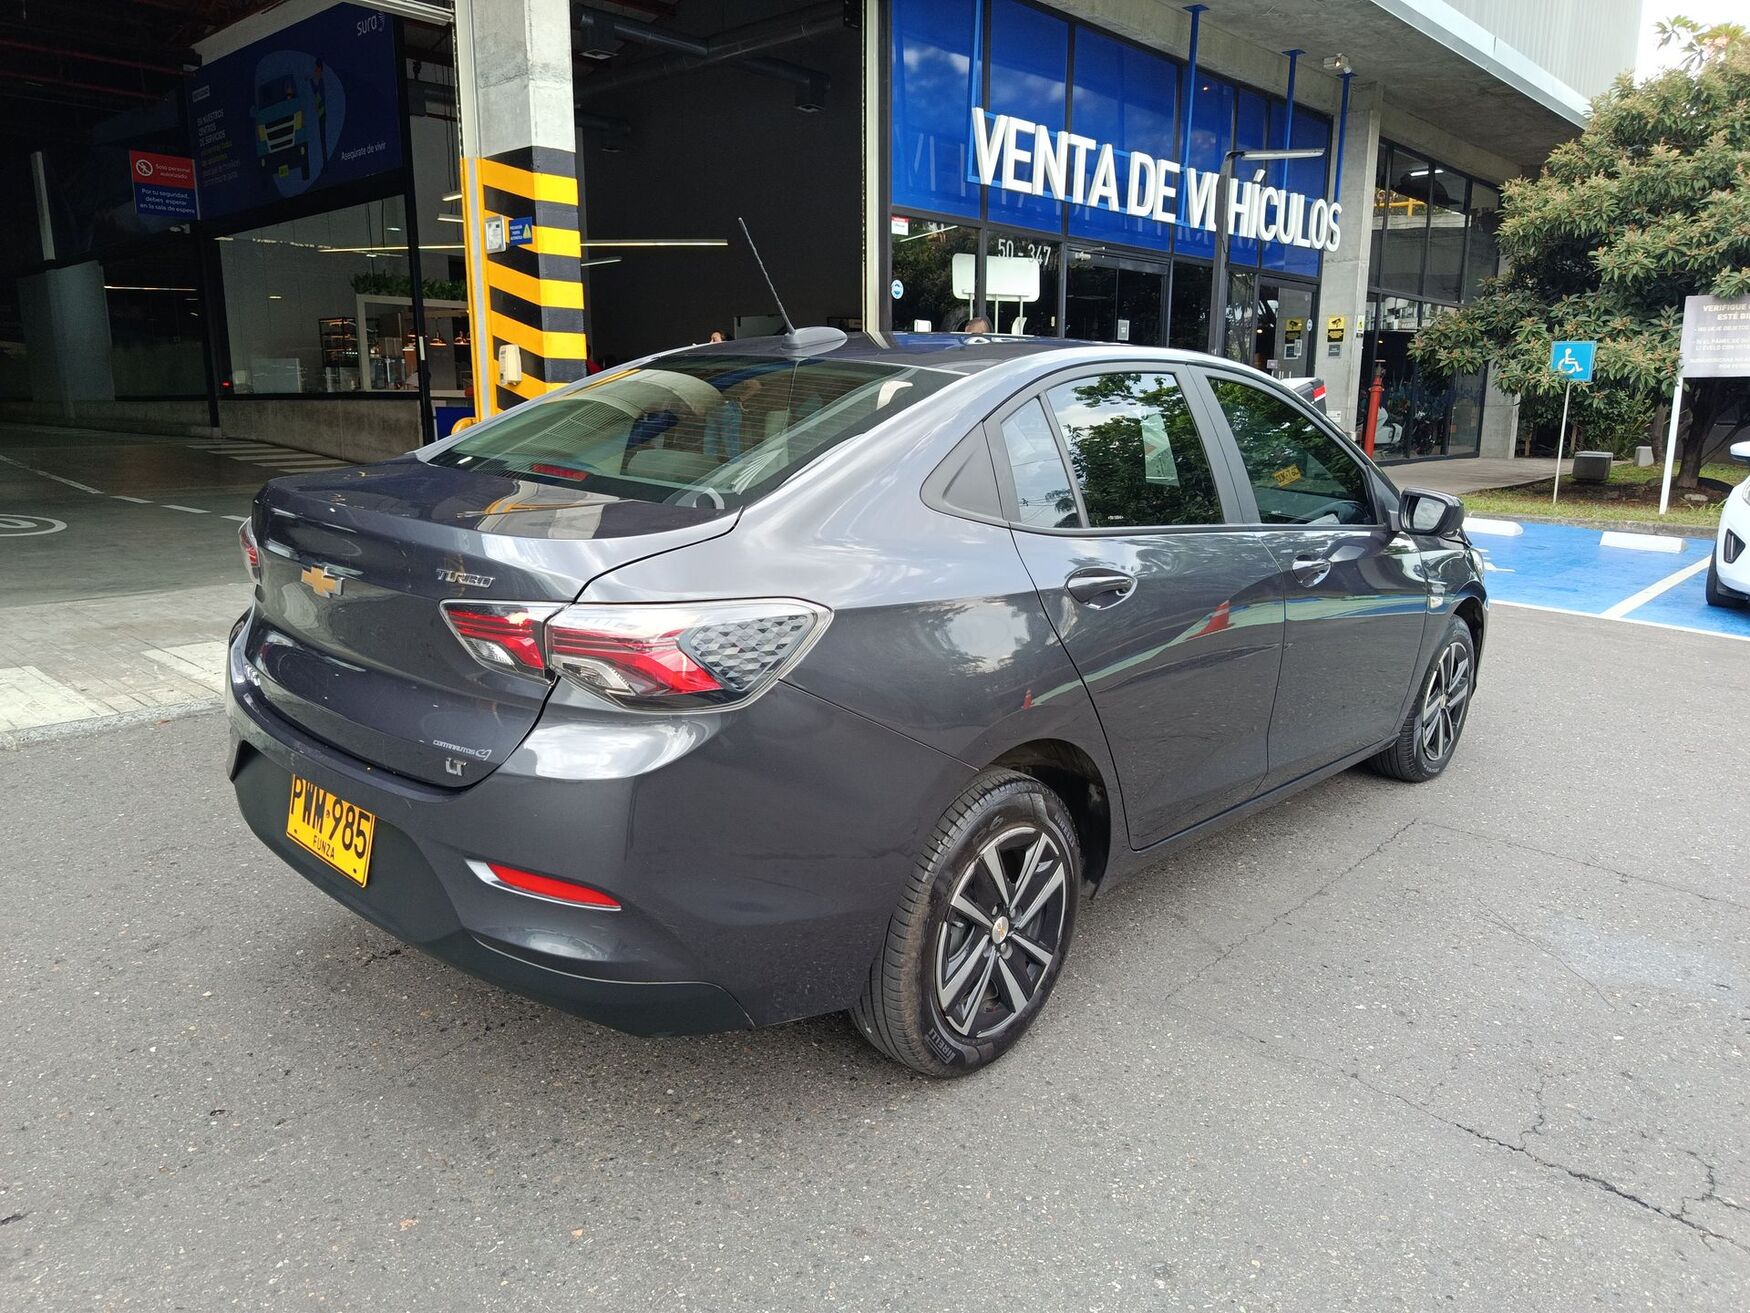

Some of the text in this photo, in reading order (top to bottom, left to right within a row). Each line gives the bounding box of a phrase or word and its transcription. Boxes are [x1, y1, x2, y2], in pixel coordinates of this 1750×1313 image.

[971, 107, 1119, 212] VENTA
[1127, 151, 1180, 224] DE
[997, 238, 1014, 258] 50
[1027, 243, 1052, 266] 347
[435, 568, 496, 588] TURBO
[445, 757, 468, 777] LT
[290, 775, 371, 859] PWM 985
[313, 834, 336, 861] FUNZA
